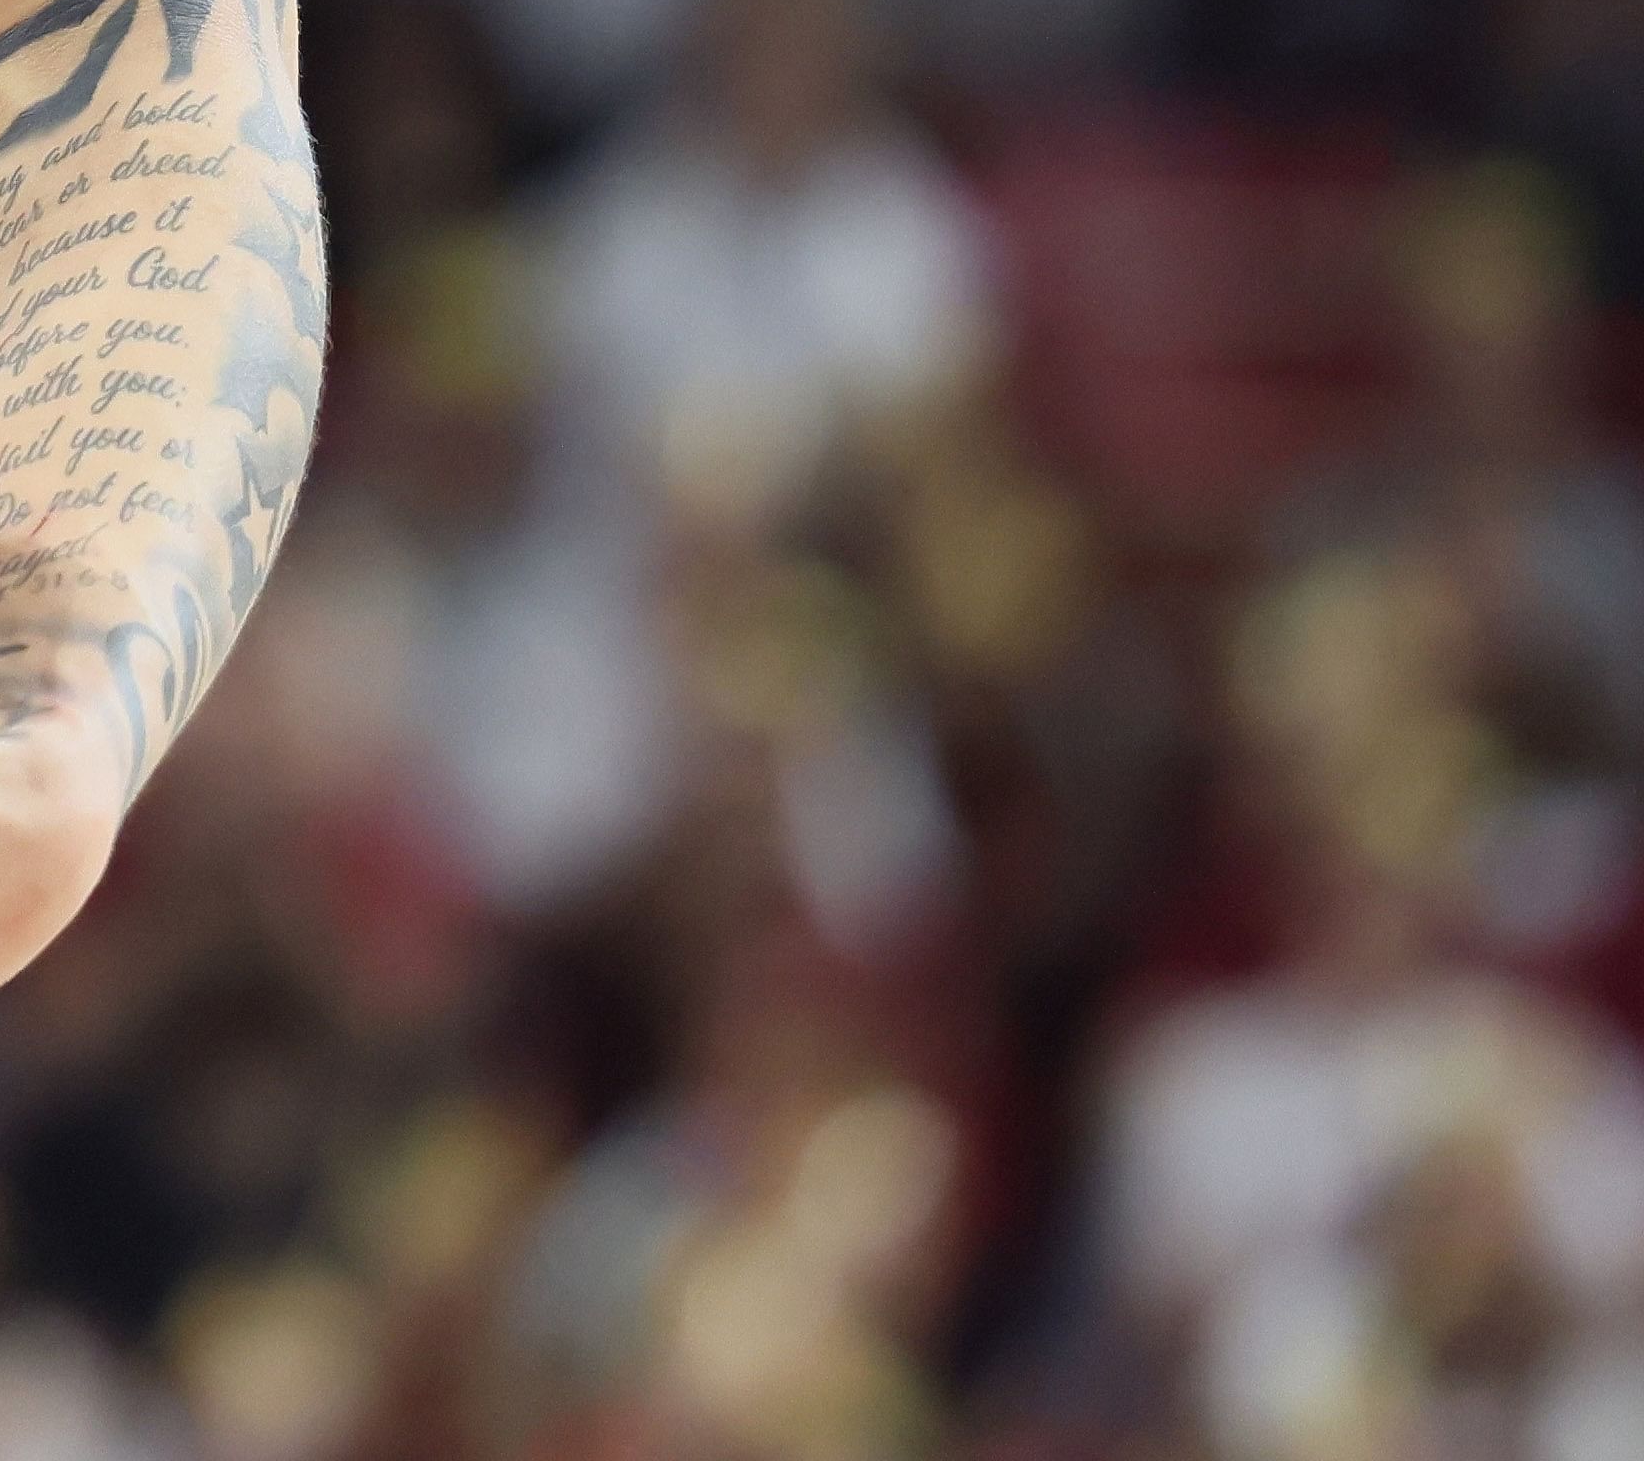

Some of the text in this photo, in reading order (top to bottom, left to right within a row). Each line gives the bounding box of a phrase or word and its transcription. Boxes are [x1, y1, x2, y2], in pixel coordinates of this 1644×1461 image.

[41, 101, 118, 170] and
[57, 172, 90, 205] or
[110, 138, 236, 181] dread
[8, 210, 138, 286] because
[156, 196, 195, 231] it
[11, 266, 108, 339] your
[127, 246, 219, 292] God
[3, 354, 83, 418] with
[65, 427, 144, 476] you
[36, 471, 118, 524] not
